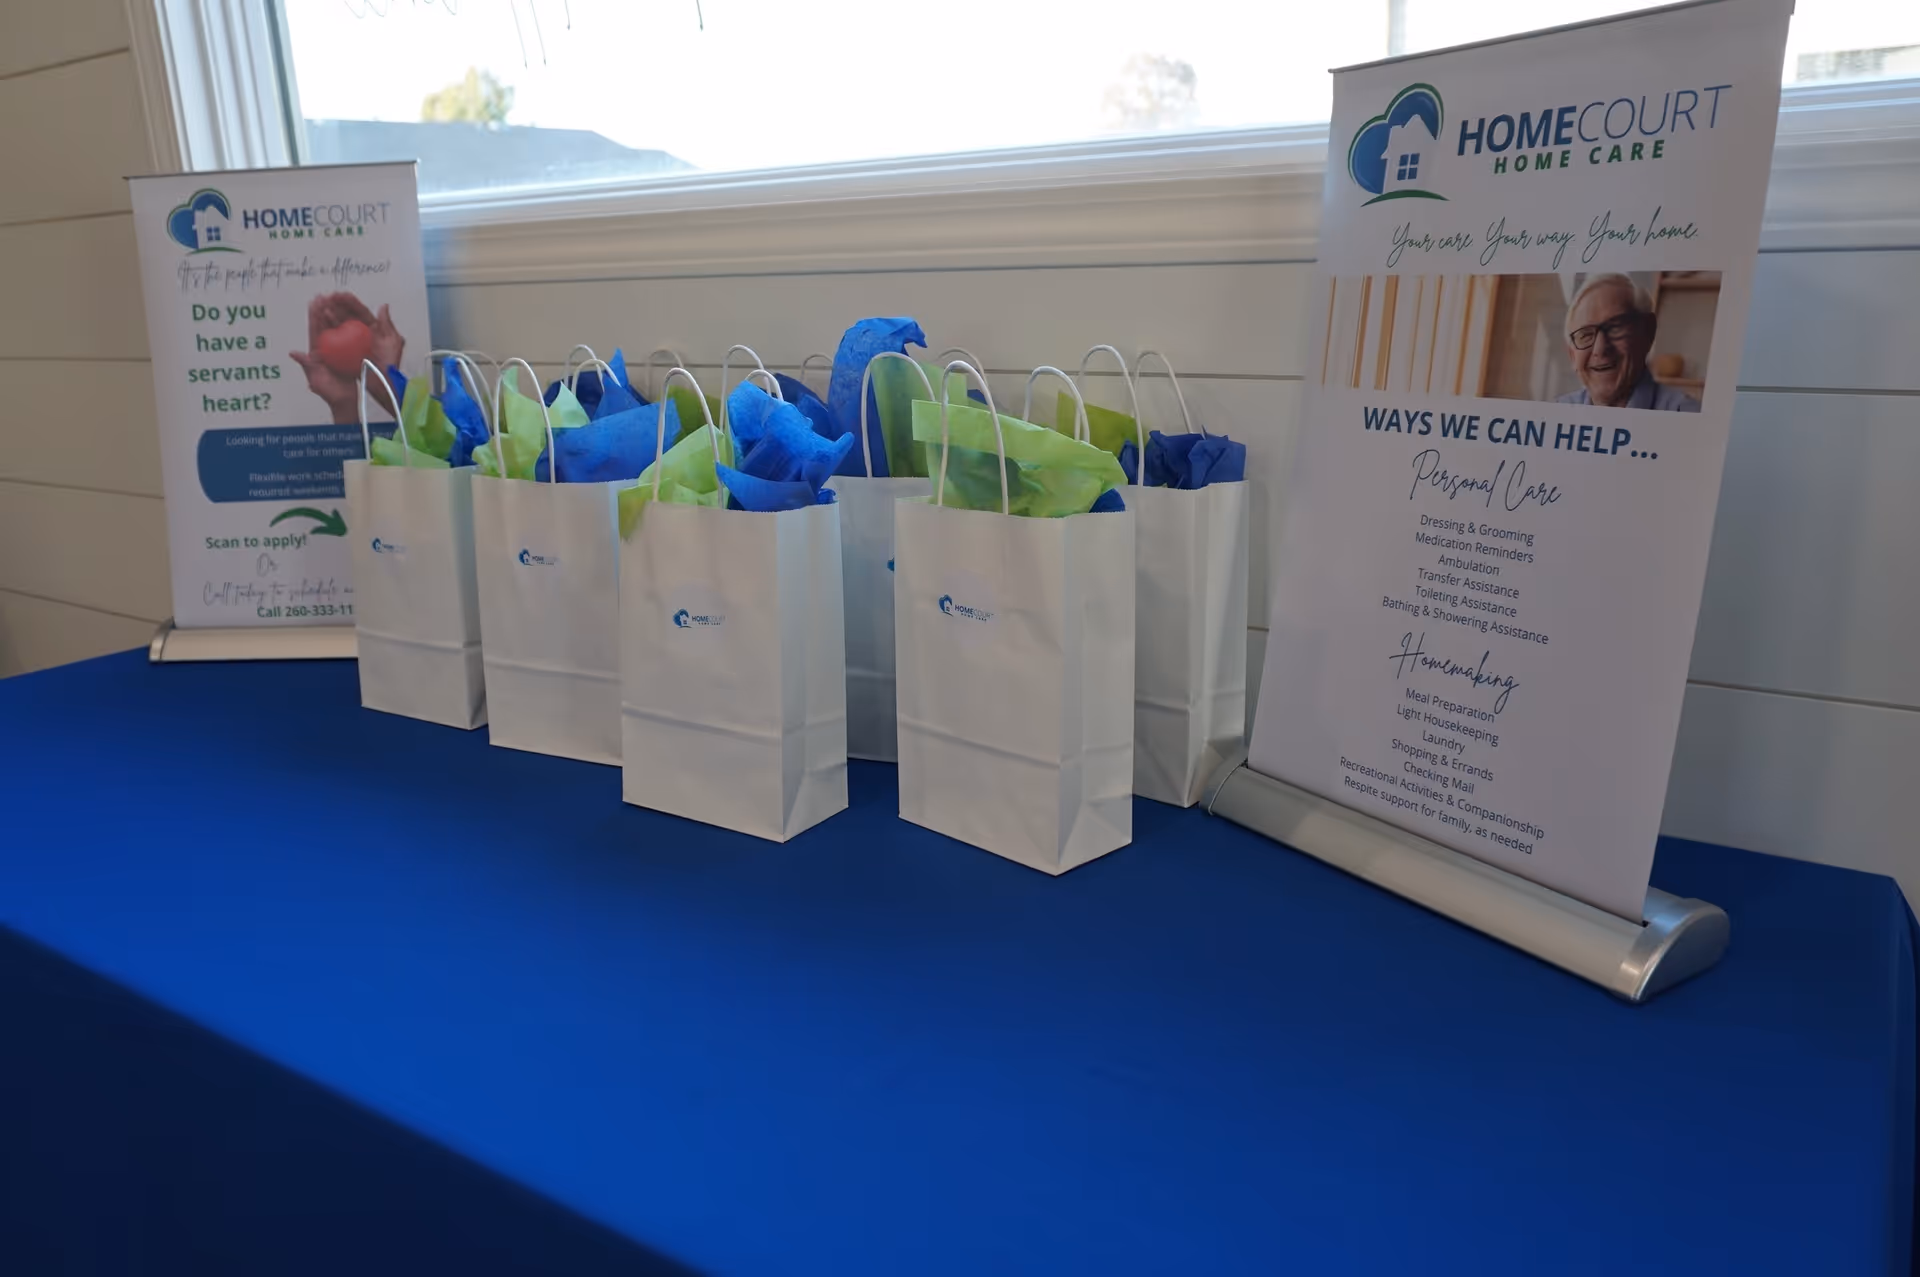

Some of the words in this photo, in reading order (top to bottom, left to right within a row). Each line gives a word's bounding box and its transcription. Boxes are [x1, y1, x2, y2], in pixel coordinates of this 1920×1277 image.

[1457, 84, 1733, 156] HOMECOURT
[1493, 150, 1572, 175] HOME
[1588, 139, 1666, 165] CARE
[243, 202, 391, 229] HOMECOURT
[269, 228, 315, 240] HOME
[324, 225, 365, 238] CARE
[1386, 220, 1435, 268] Your
[1479, 216, 1532, 267] Your
[1581, 209, 1640, 264] Your
[1643, 206, 1700, 247] home.
[192, 303, 220, 321] Do
[226, 304, 266, 326] you
[196, 333, 249, 352] have
[254, 336, 266, 350] a
[187, 363, 281, 383] servants
[202, 391, 272, 413] heart?
[226, 434, 264, 447] Looking
[265, 433, 281, 444] for
[282, 433, 315, 446] people
[317, 432, 337, 442] that
[1363, 406, 1433, 436] WAYS
[1440, 412, 1480, 441] WE
[1487, 417, 1546, 447] CAN
[1554, 422, 1659, 460] HELP...
[288, 470, 310, 481] work
[313, 470, 344, 481] sched
[1410, 449, 1505, 508] Personal
[1504, 460, 1562, 512] Care
[205, 536, 240, 550] Scan
[244, 535, 258, 547] to
[263, 533, 307, 551] apply!
[1419, 514, 1465, 534] Dressing
[1467, 522, 1476, 534] &
[1479, 524, 1535, 547] Grooming
[1415, 531, 1472, 552] Medication
[1475, 542, 1534, 564] Reminders
[1438, 554, 1500, 577] Ambulation
[1418, 567, 1461, 587] Transfer
[1463, 578, 1520, 600] Assistance
[257, 606, 282, 618] Call
[286, 604, 354, 618] 260-333-11
[1415, 585, 1459, 607] Toileting
[1461, 595, 1518, 618] Assistance
[1382, 596, 1420, 618] Bathing
[1422, 605, 1431, 617] &
[1432, 607, 1489, 632] Showering
[1491, 620, 1549, 645] Assistance
[1389, 631, 1520, 715] Homemaking
[1405, 687, 1430, 705] Meal
[1432, 694, 1496, 724] Preparation
[1396, 703, 1421, 723] Light
[1423, 711, 1500, 748] Housekeeping
[1422, 730, 1466, 755] Laundry
[1391, 738, 1439, 766] Shopping
[1440, 754, 1449, 766] &
[1451, 757, 1494, 782] Errands
[1403, 761, 1450, 787] Checking
[1452, 775, 1475, 795] Mail
[1339, 756, 1398, 786] Recreational
[1399, 777, 1444, 804] Activities
[1446, 794, 1455, 807] &
[1457, 797, 1546, 841] Companionship
[1344, 775, 1379, 798] Respite
[1380, 787, 1419, 813] support
[1420, 799, 1437, 817] for
[1438, 807, 1473, 835] family,
[1474, 825, 1488, 838] as
[1490, 829, 1534, 855] needed
